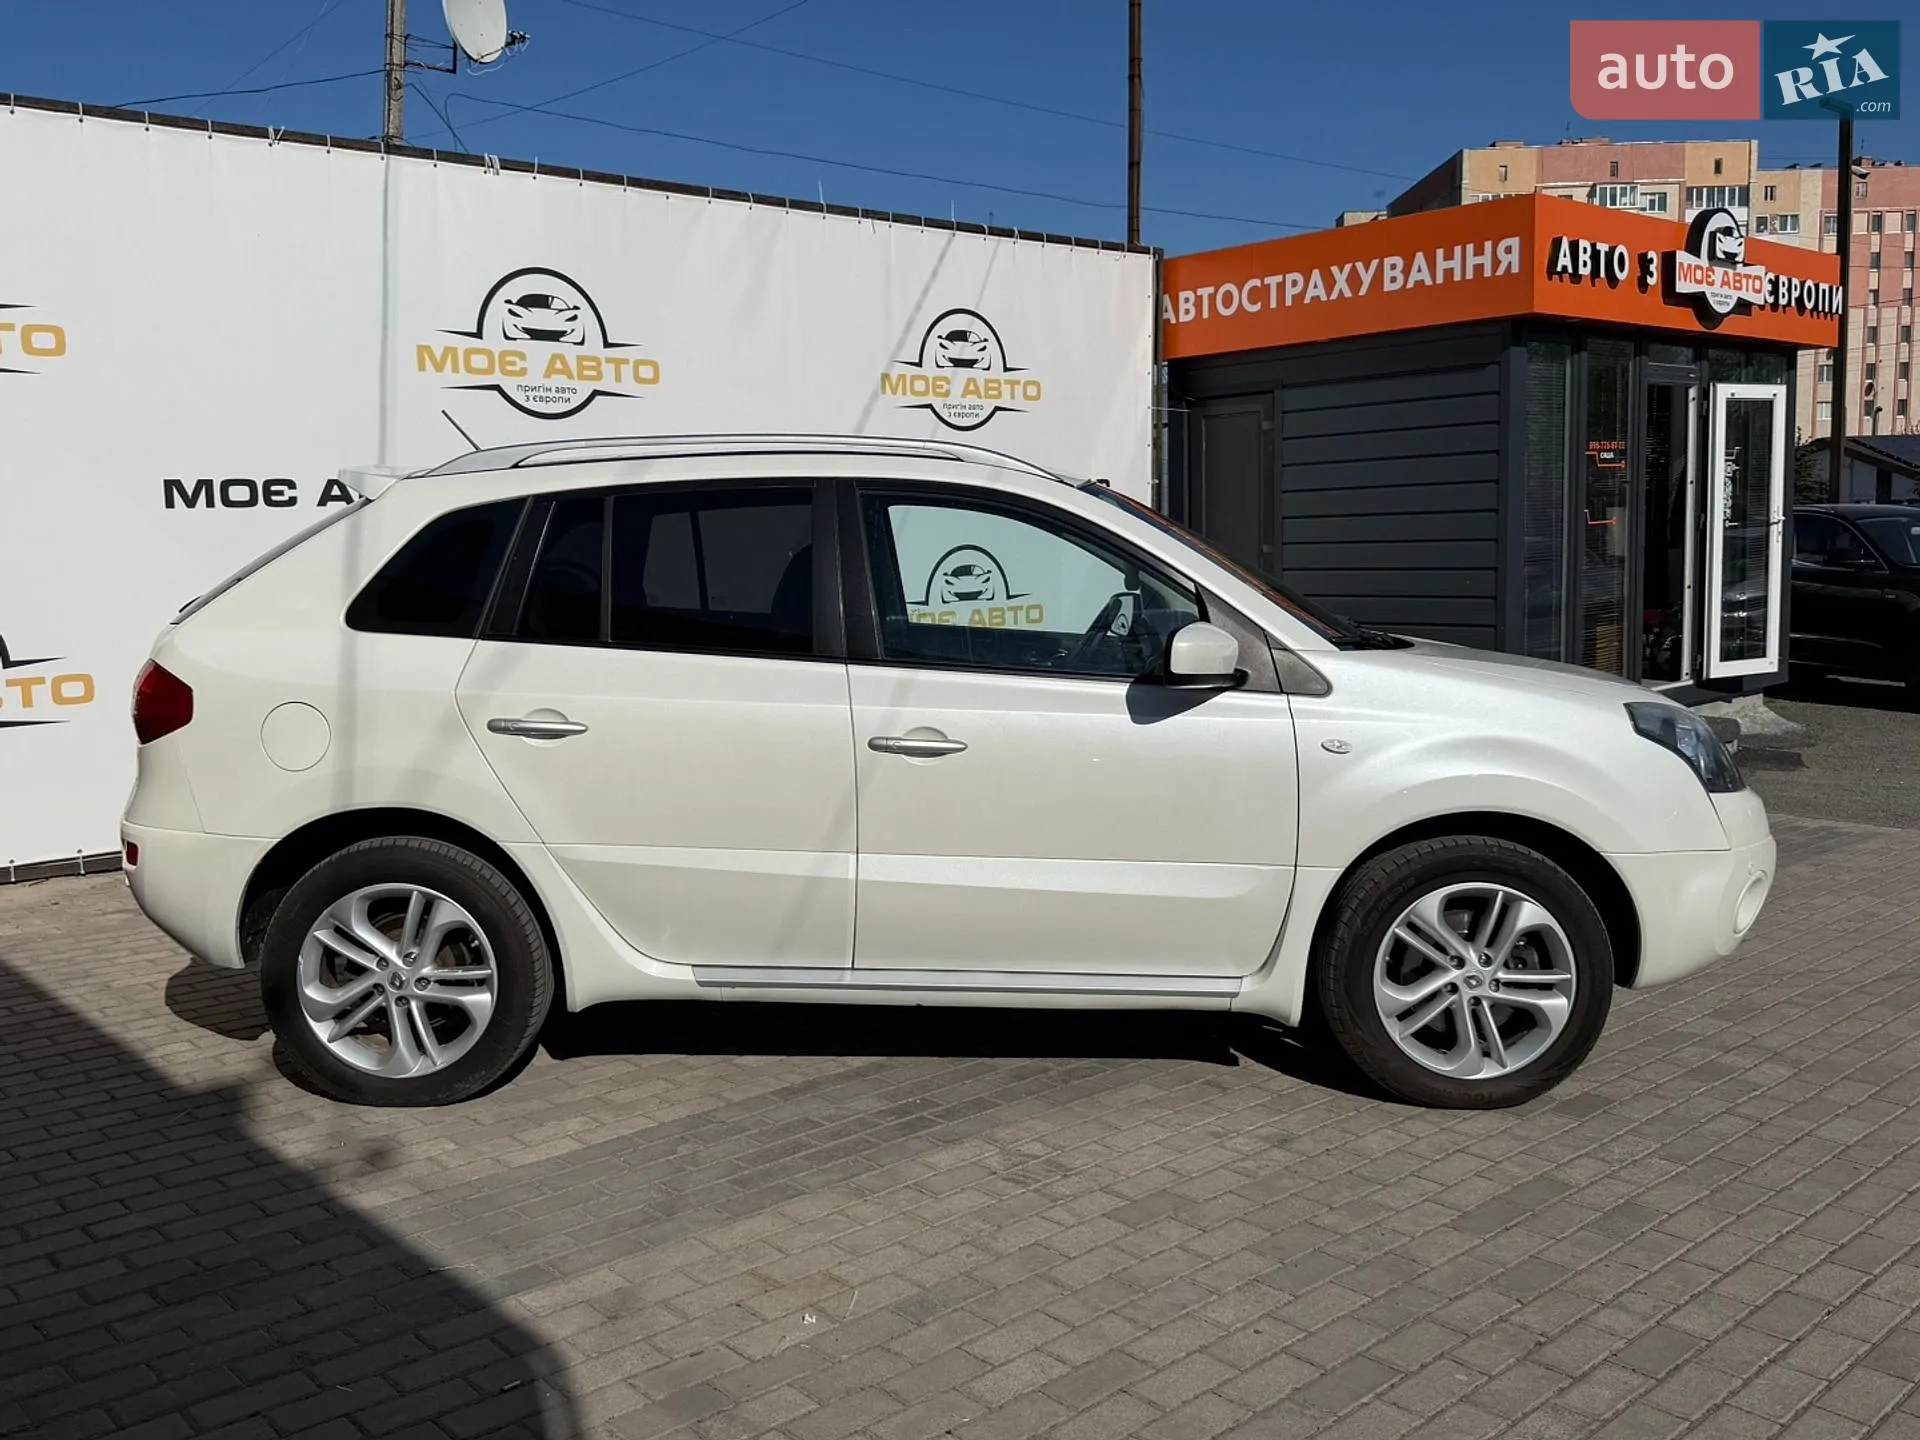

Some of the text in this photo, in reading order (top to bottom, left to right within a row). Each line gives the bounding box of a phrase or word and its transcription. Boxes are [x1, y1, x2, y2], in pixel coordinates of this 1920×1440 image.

[1162, 236, 1521, 325] АВТОСТРАХУВАННЯ
[1556, 235, 1630, 281] АВТО
[1765, 272, 1843, 315] ЄВРОПИ
[1678, 261, 1764, 295] МОЄ АВТО
[416, 344, 661, 385] МОЄ АВТО
[516, 384, 578, 395] пригін авто
[532, 394, 571, 404] європи
[880, 373, 1042, 402] МОЄ АВТО
[163, 478, 298, 509] МОЄ
[968, 604, 1044, 628] АВТО
